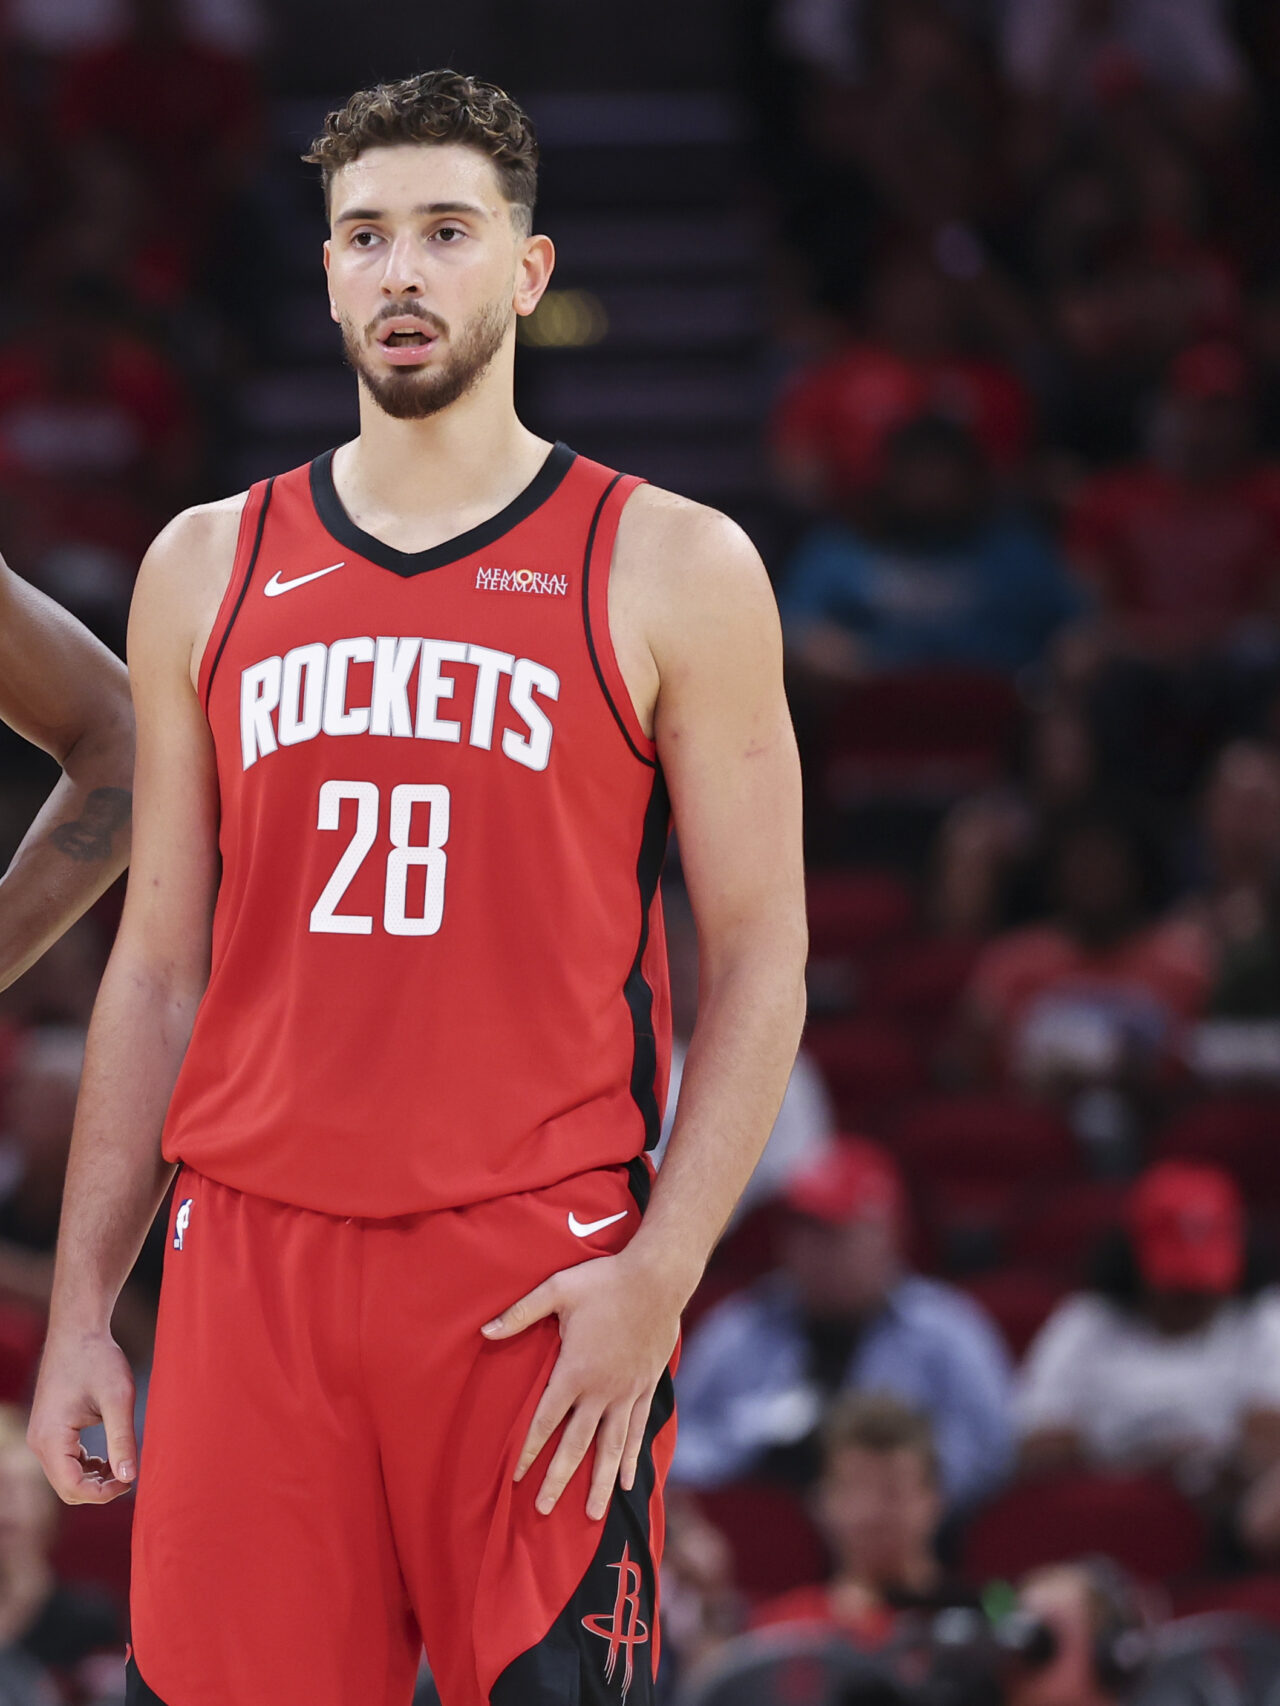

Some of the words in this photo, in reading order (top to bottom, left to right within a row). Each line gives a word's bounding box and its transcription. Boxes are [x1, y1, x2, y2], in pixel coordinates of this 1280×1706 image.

[475, 577, 568, 596] HERMANN
[477, 566, 568, 586] MEMORIAL
[240, 636, 560, 771] ROCKETS
[309, 780, 451, 936] 28
